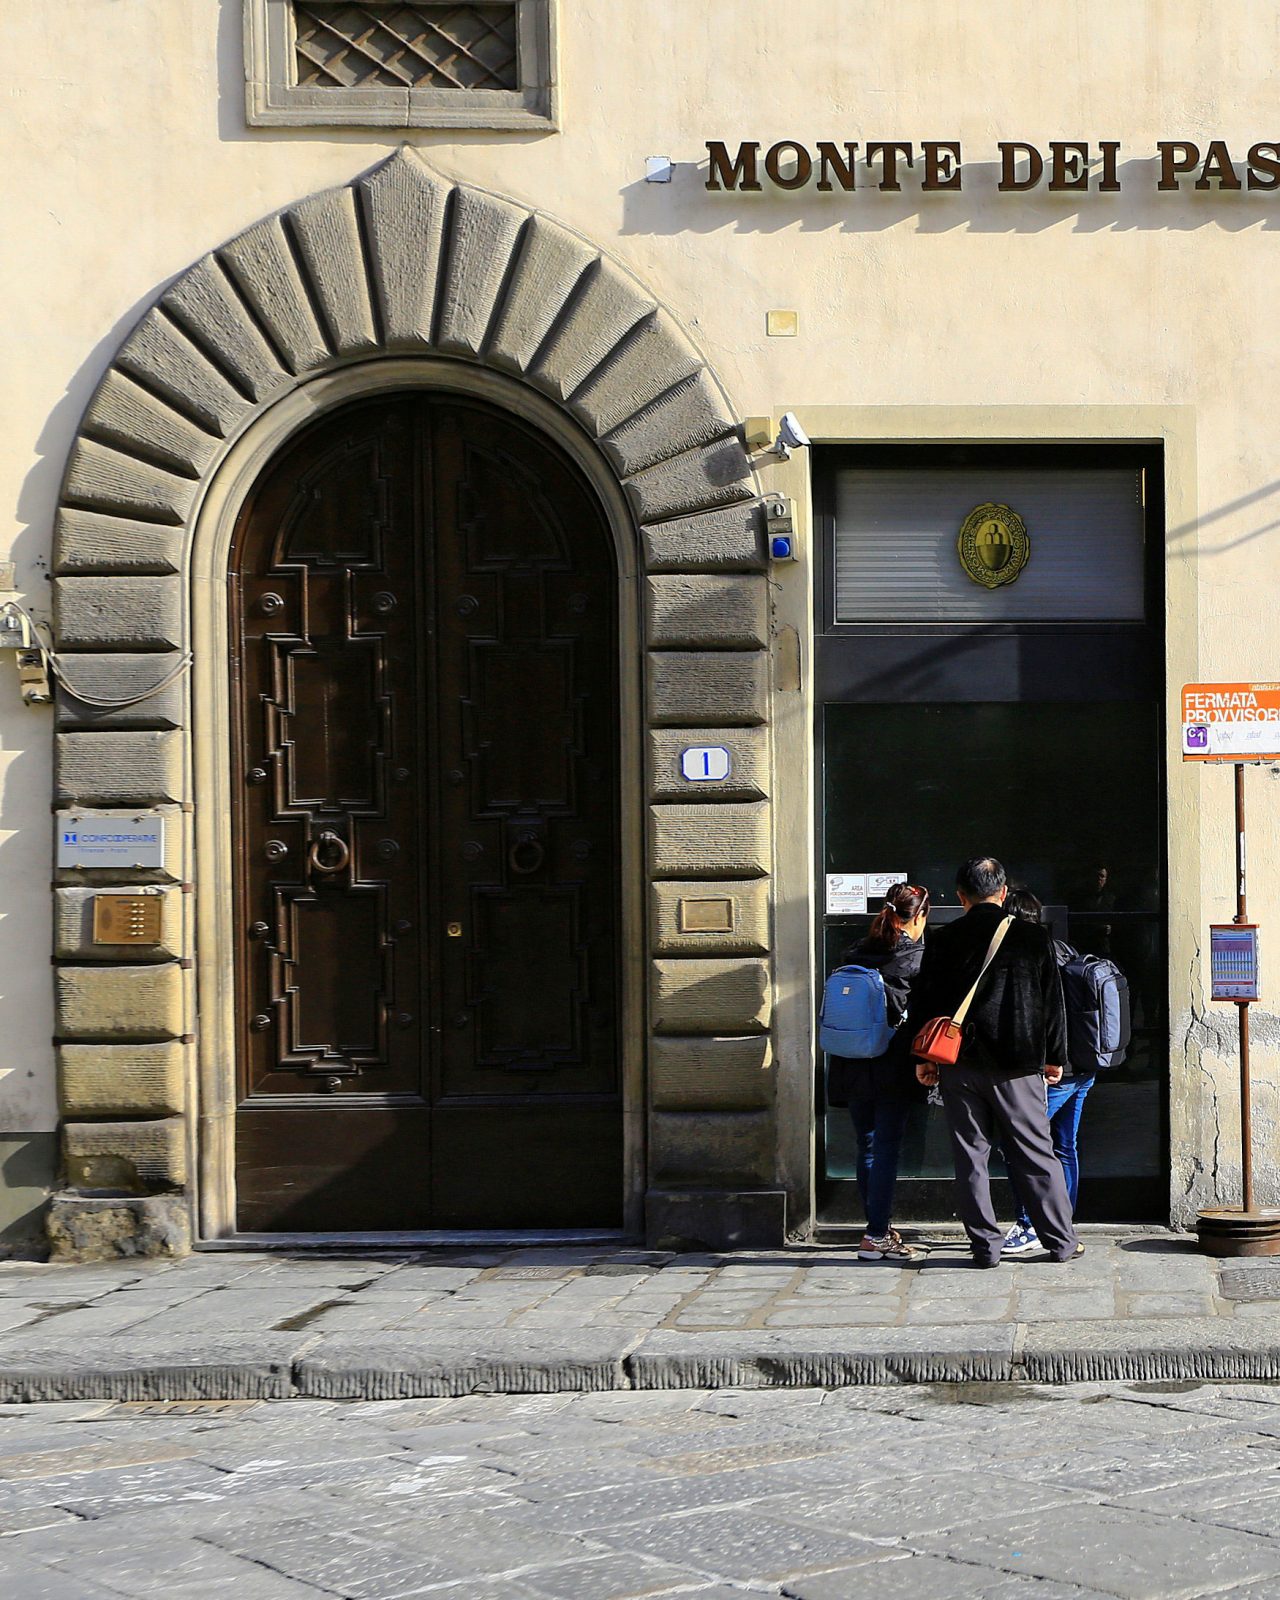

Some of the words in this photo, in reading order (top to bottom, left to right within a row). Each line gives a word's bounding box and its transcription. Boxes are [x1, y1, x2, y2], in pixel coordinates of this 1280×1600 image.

[705, 141, 962, 191] MONTE
[998, 141, 1121, 191] DEI
[1185, 692, 1258, 708] FERMATA
[703, 752, 709, 776] 1
